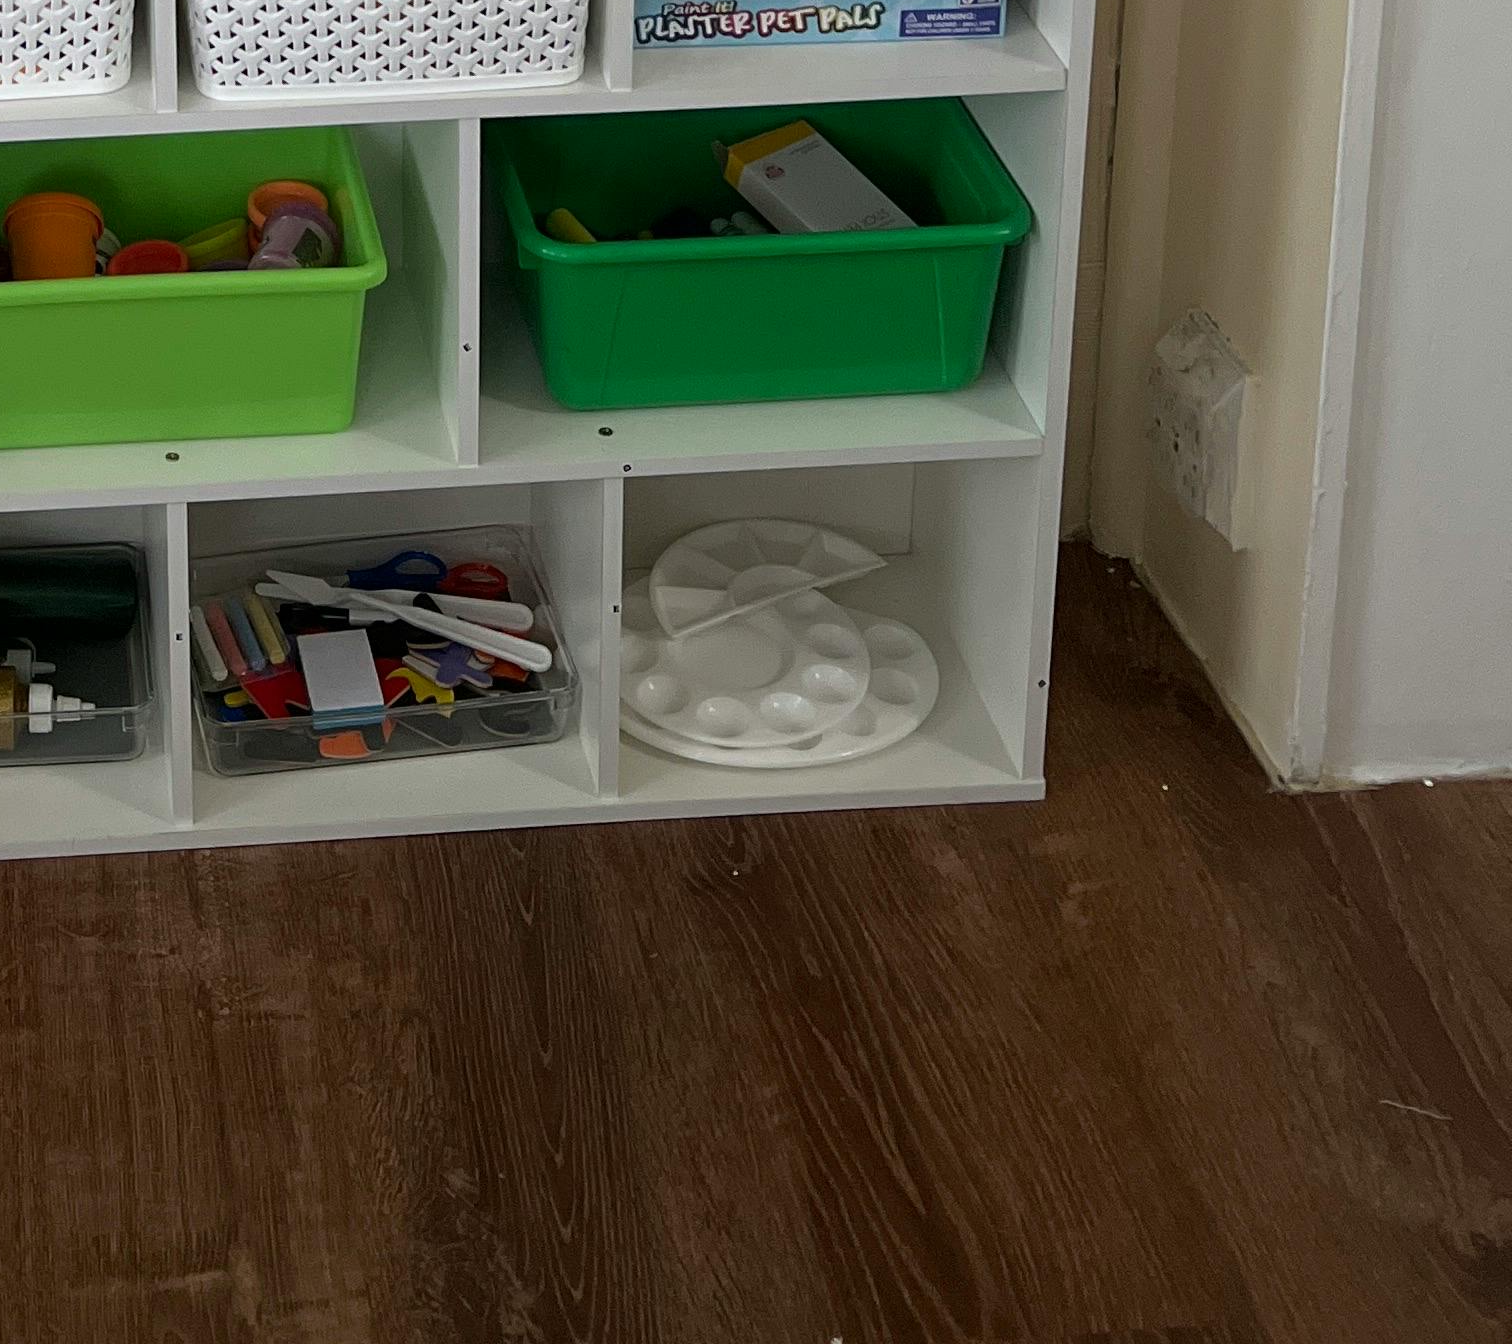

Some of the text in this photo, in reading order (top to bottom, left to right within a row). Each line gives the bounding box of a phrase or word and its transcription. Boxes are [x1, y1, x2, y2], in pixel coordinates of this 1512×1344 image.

[637, 11, 753, 43] PLASTER
[757, 6, 817, 37] PET
[818, 2, 885, 32] PALS
[663, 2, 711, 16] Paint
